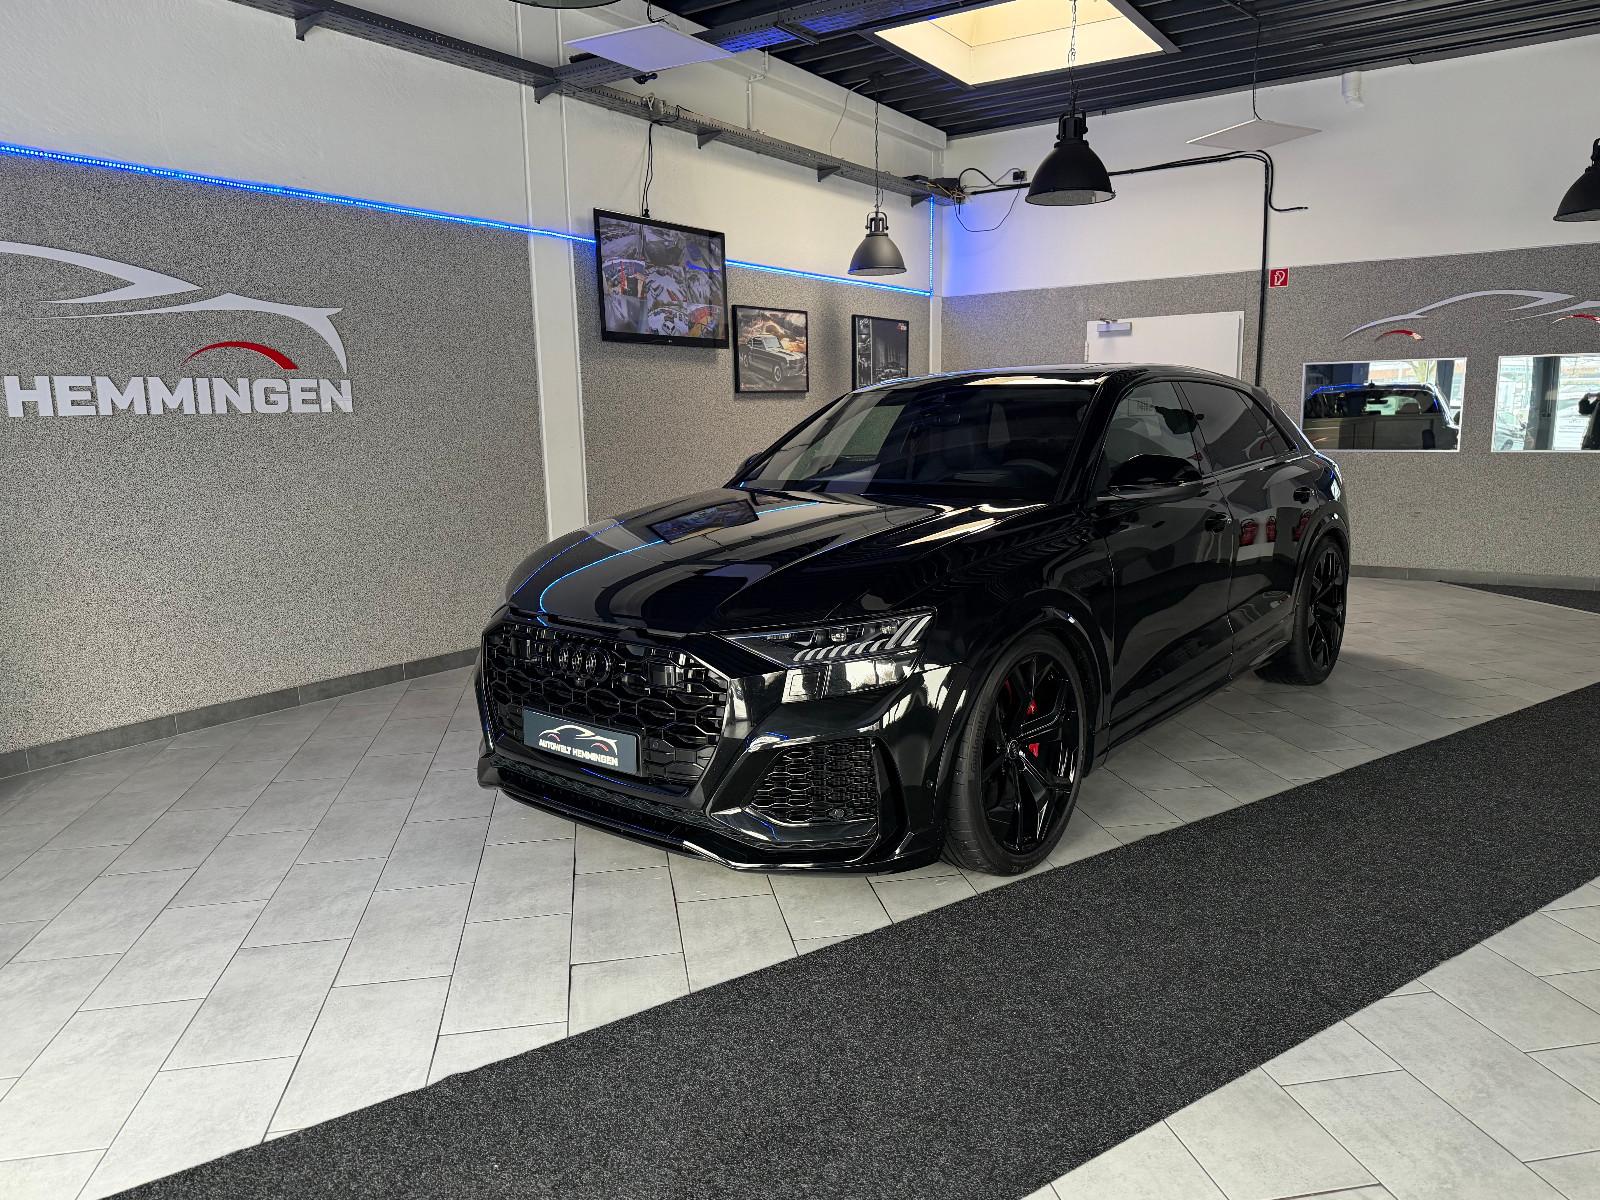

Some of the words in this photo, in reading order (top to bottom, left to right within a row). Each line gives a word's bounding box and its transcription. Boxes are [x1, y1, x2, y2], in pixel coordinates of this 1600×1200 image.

[4, 375, 353, 418] HEMMINGEN
[539, 739, 571, 754] AUTOWELT
[572, 747, 619, 766] HEMMINGEN
